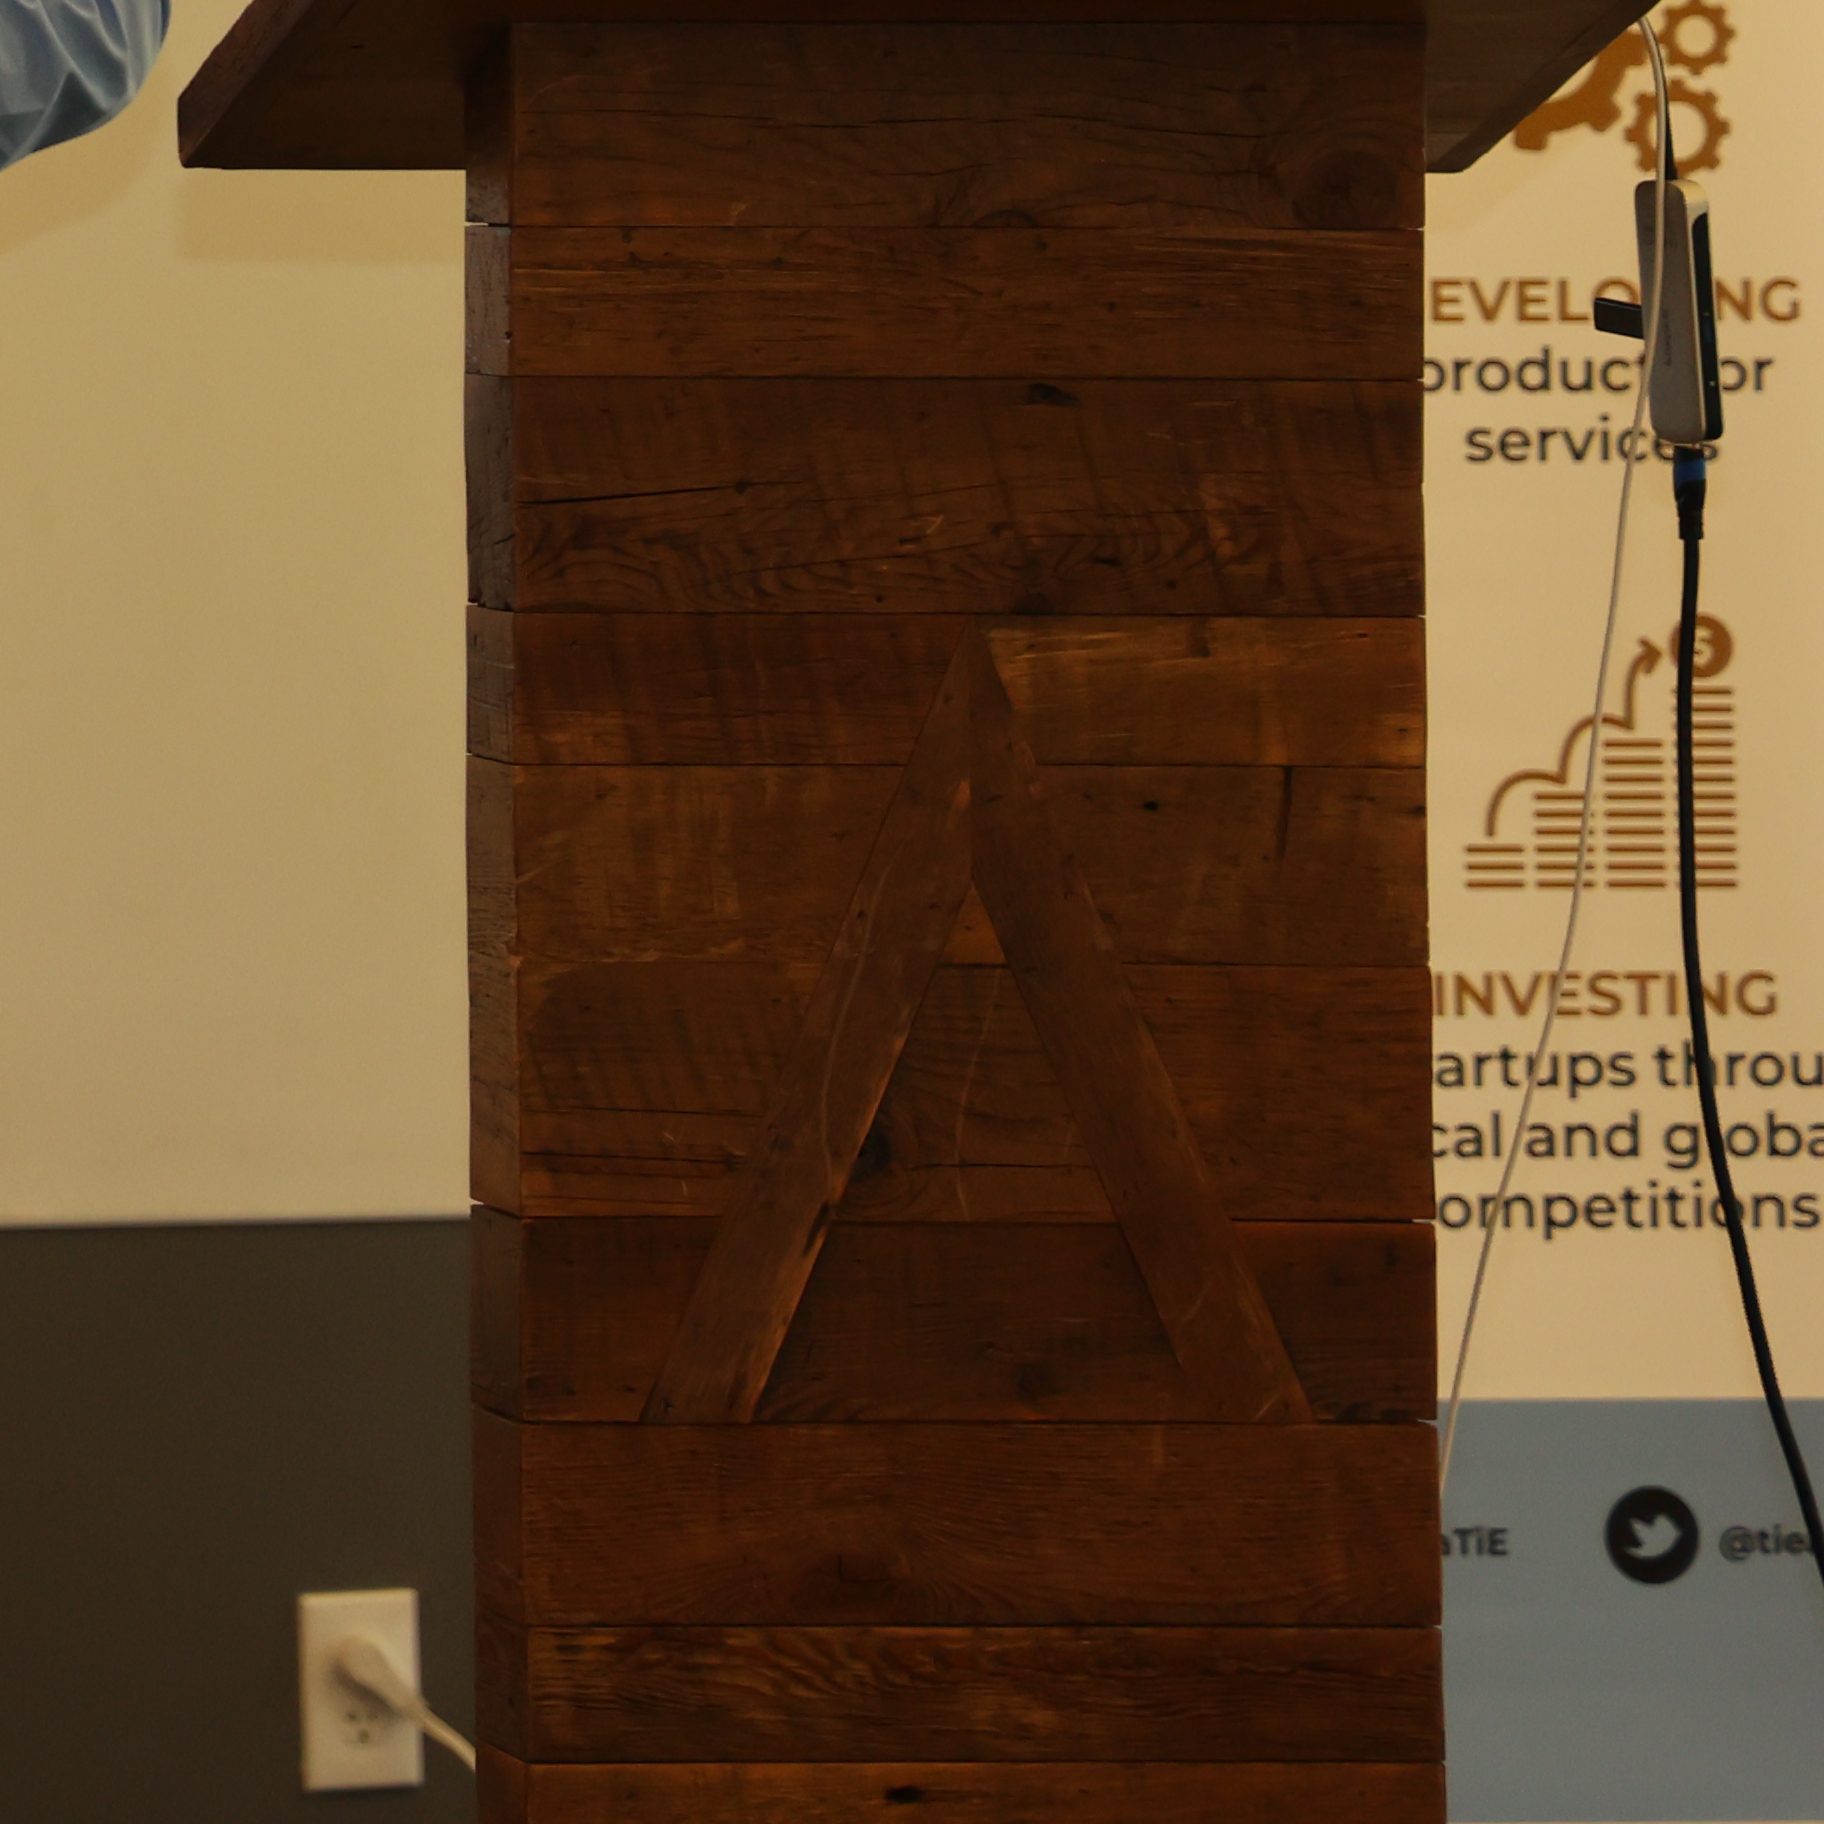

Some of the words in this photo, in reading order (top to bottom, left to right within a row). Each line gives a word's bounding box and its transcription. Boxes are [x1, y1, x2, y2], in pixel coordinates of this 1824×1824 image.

[1424, 345, 1648, 393] produc
[1433, 970, 1778, 1018] INVESTING
[1435, 1045, 1637, 1100] artups
[1524, 1108, 1641, 1159] and
[1664, 1109, 1824, 1171] goba
[1437, 1179, 1822, 1241] ompetitions
[1718, 1523, 1814, 1564] @tie
